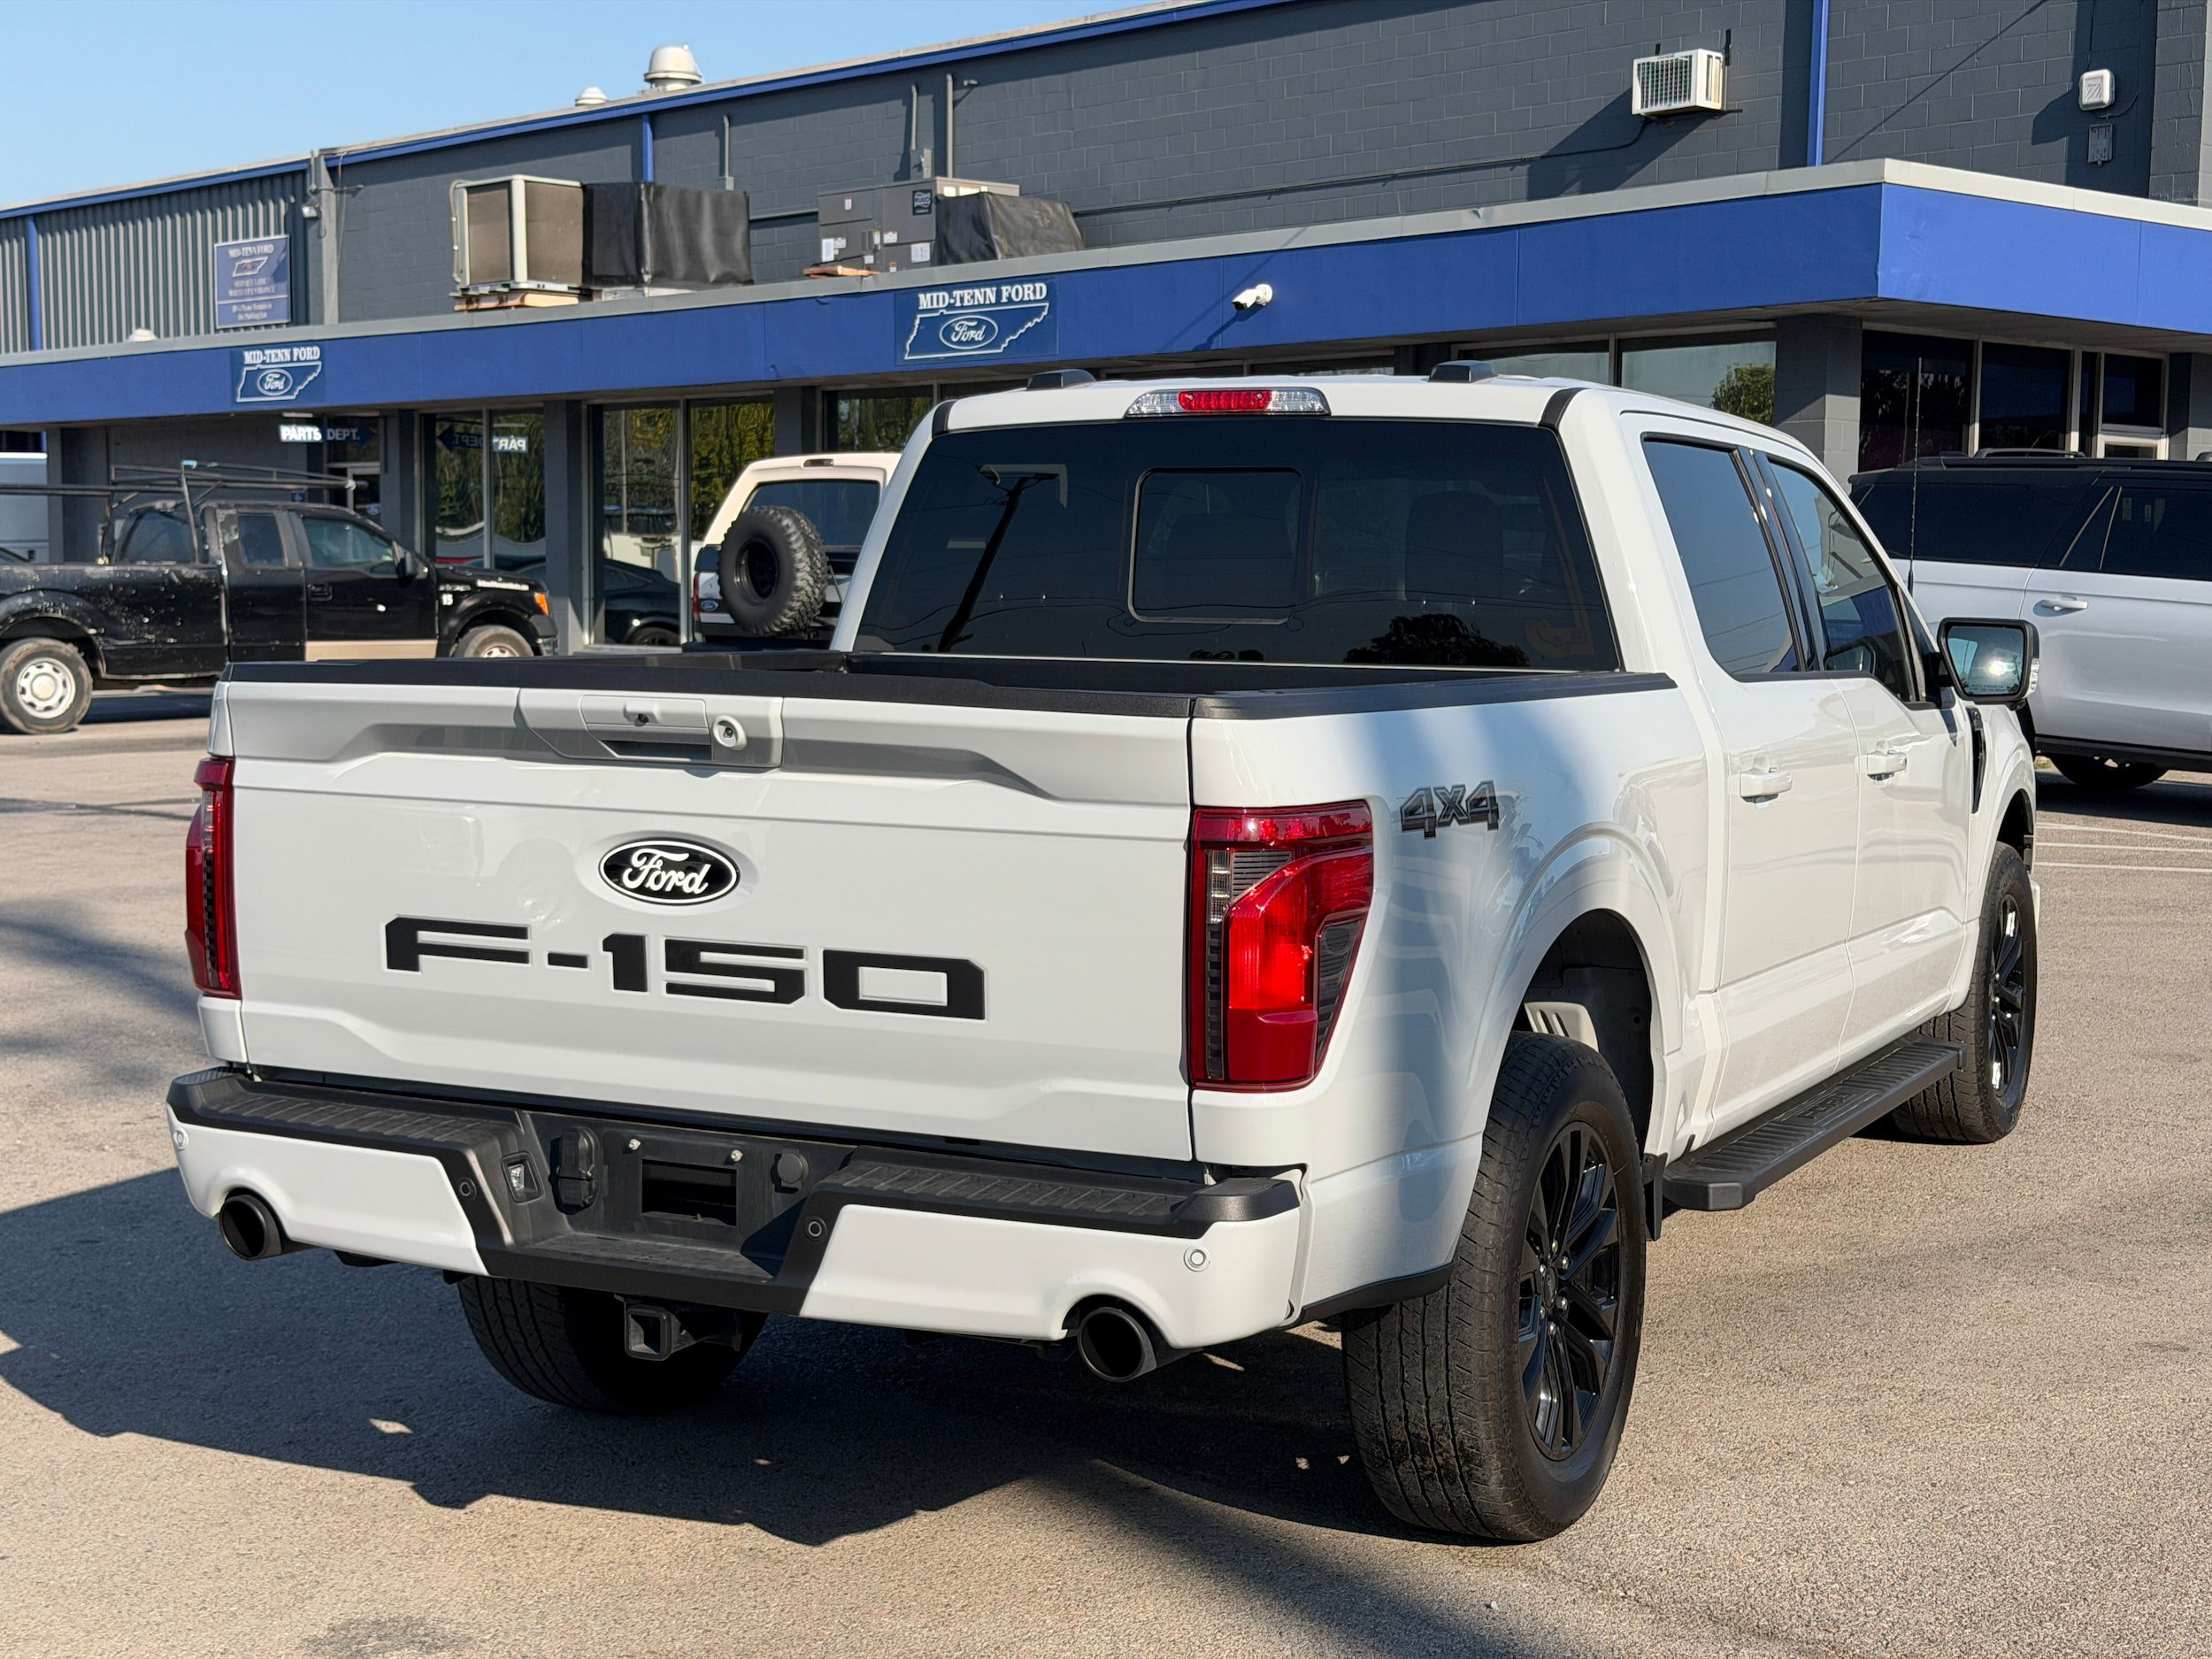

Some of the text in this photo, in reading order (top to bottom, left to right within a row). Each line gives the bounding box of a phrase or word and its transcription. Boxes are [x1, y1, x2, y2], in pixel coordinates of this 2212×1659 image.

[918, 282, 1047, 310] MID-TENN FORD
[950, 320, 987, 342] Ford
[243, 346, 321, 365] MID-TENN FORD
[264, 373, 286, 390] Ford
[280, 425, 322, 442] PARTS
[622, 847, 711, 895] Ford
[385, 916, 986, 1021] F-150
